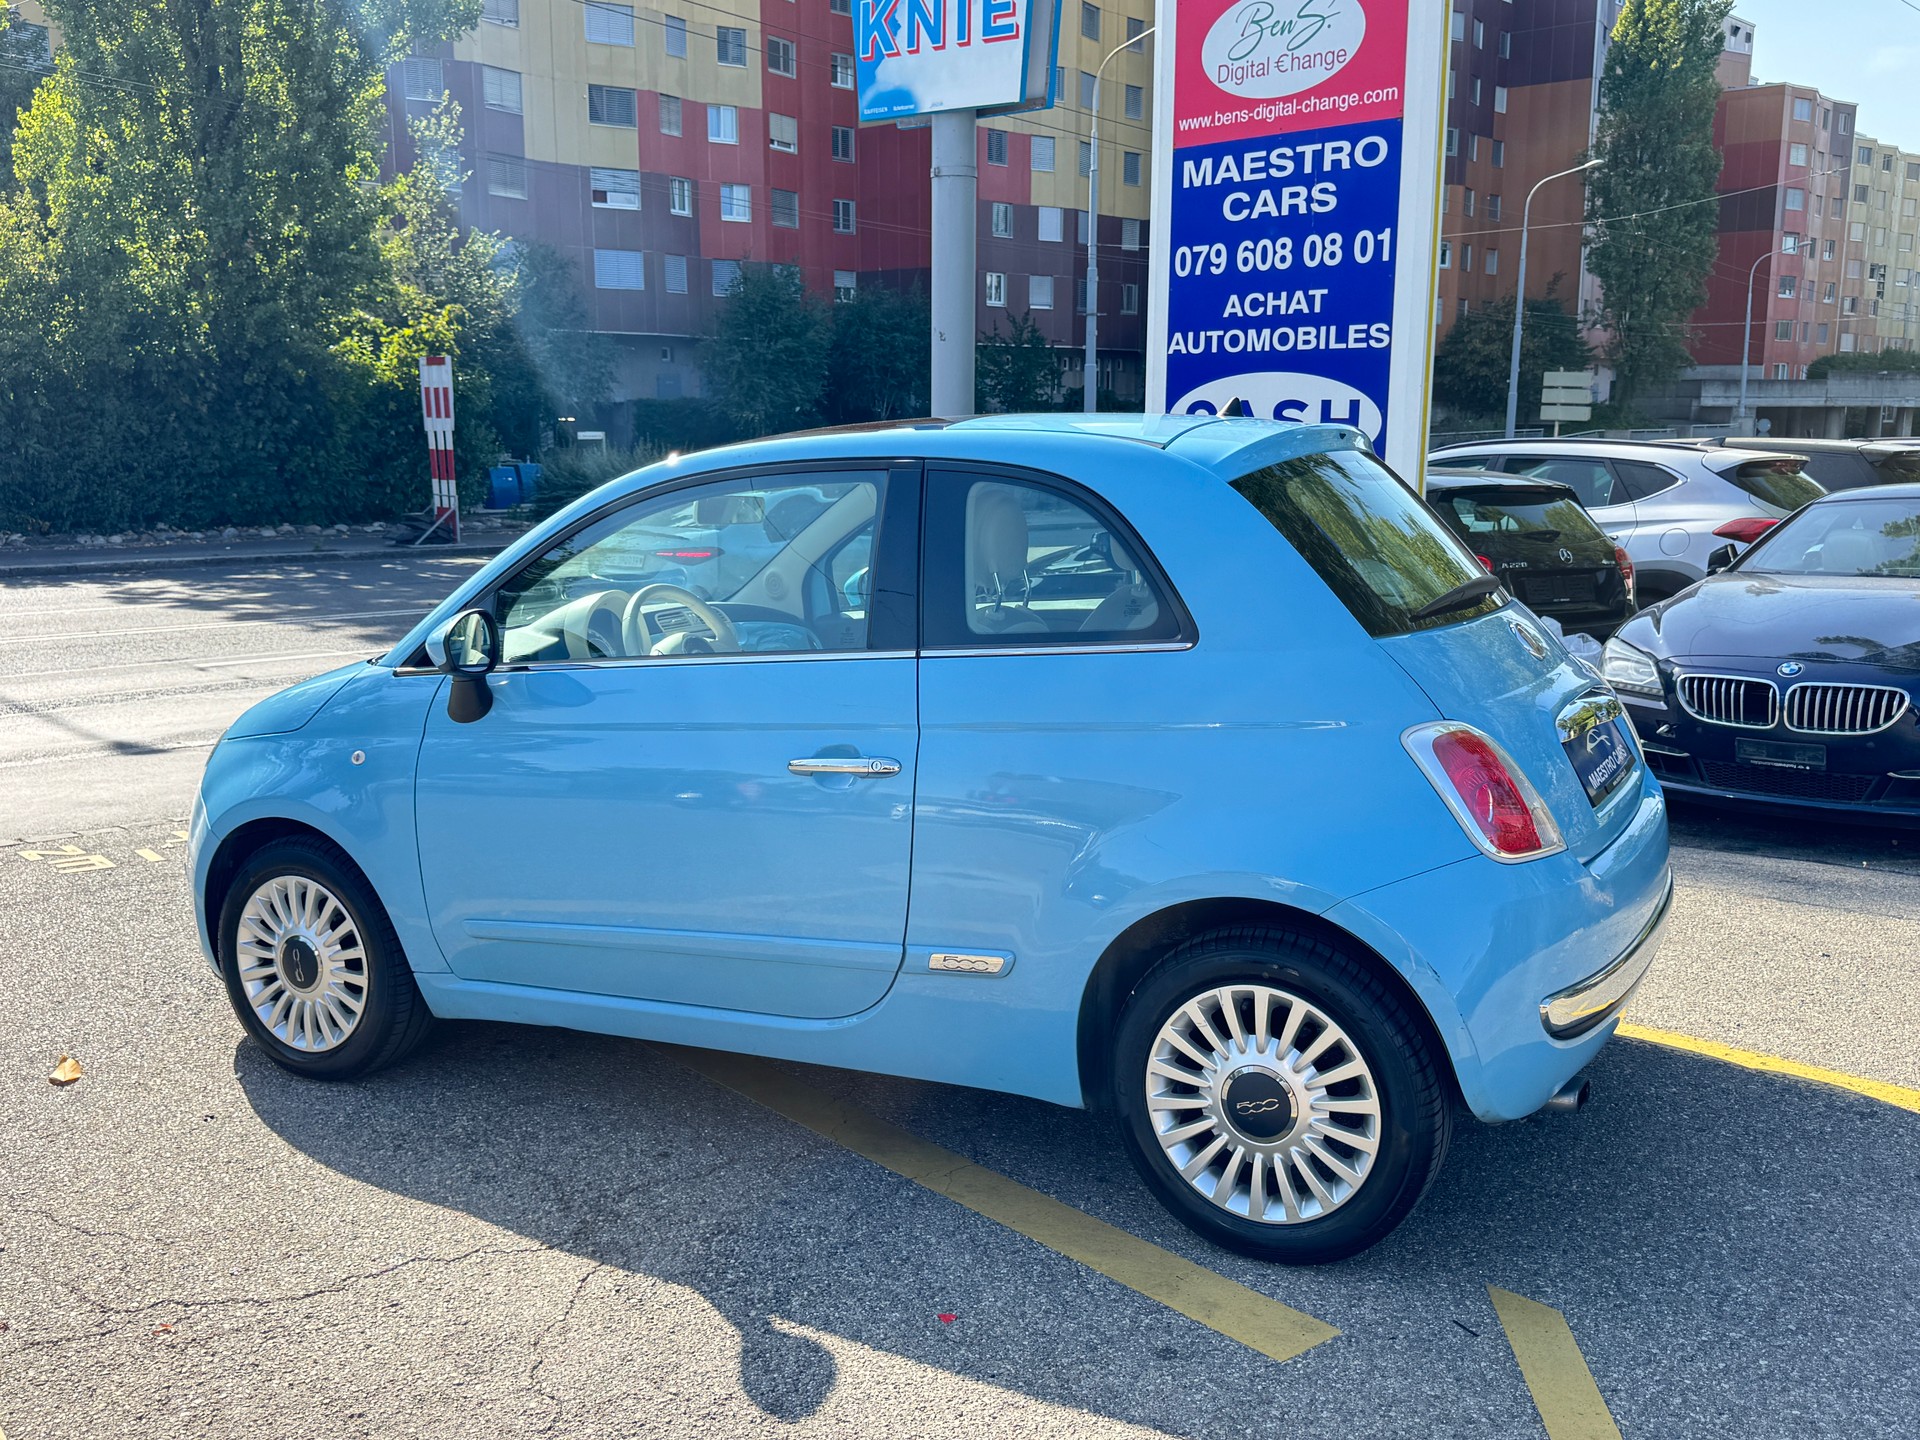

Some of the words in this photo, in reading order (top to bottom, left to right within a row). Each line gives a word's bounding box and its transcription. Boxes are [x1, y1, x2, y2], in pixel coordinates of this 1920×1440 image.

[860, 0, 1020, 62] KNIE
[1217, 57, 1271, 86] Digital
[1179, 87, 1399, 131] www.bens-digital-change.com
[1182, 136, 1389, 188] MAESTRO
[1222, 182, 1338, 222] CARS
[1174, 243, 1228, 277] 079
[1236, 237, 1293, 273] 608
[1302, 232, 1343, 268] 08
[1353, 228, 1392, 264] 01
[1223, 289, 1329, 318] ACHAT
[1168, 323, 1391, 355] AUTOMOBILES
[1588, 755, 1617, 789] MAESTRO
[1612, 744, 1627, 765] CARS
